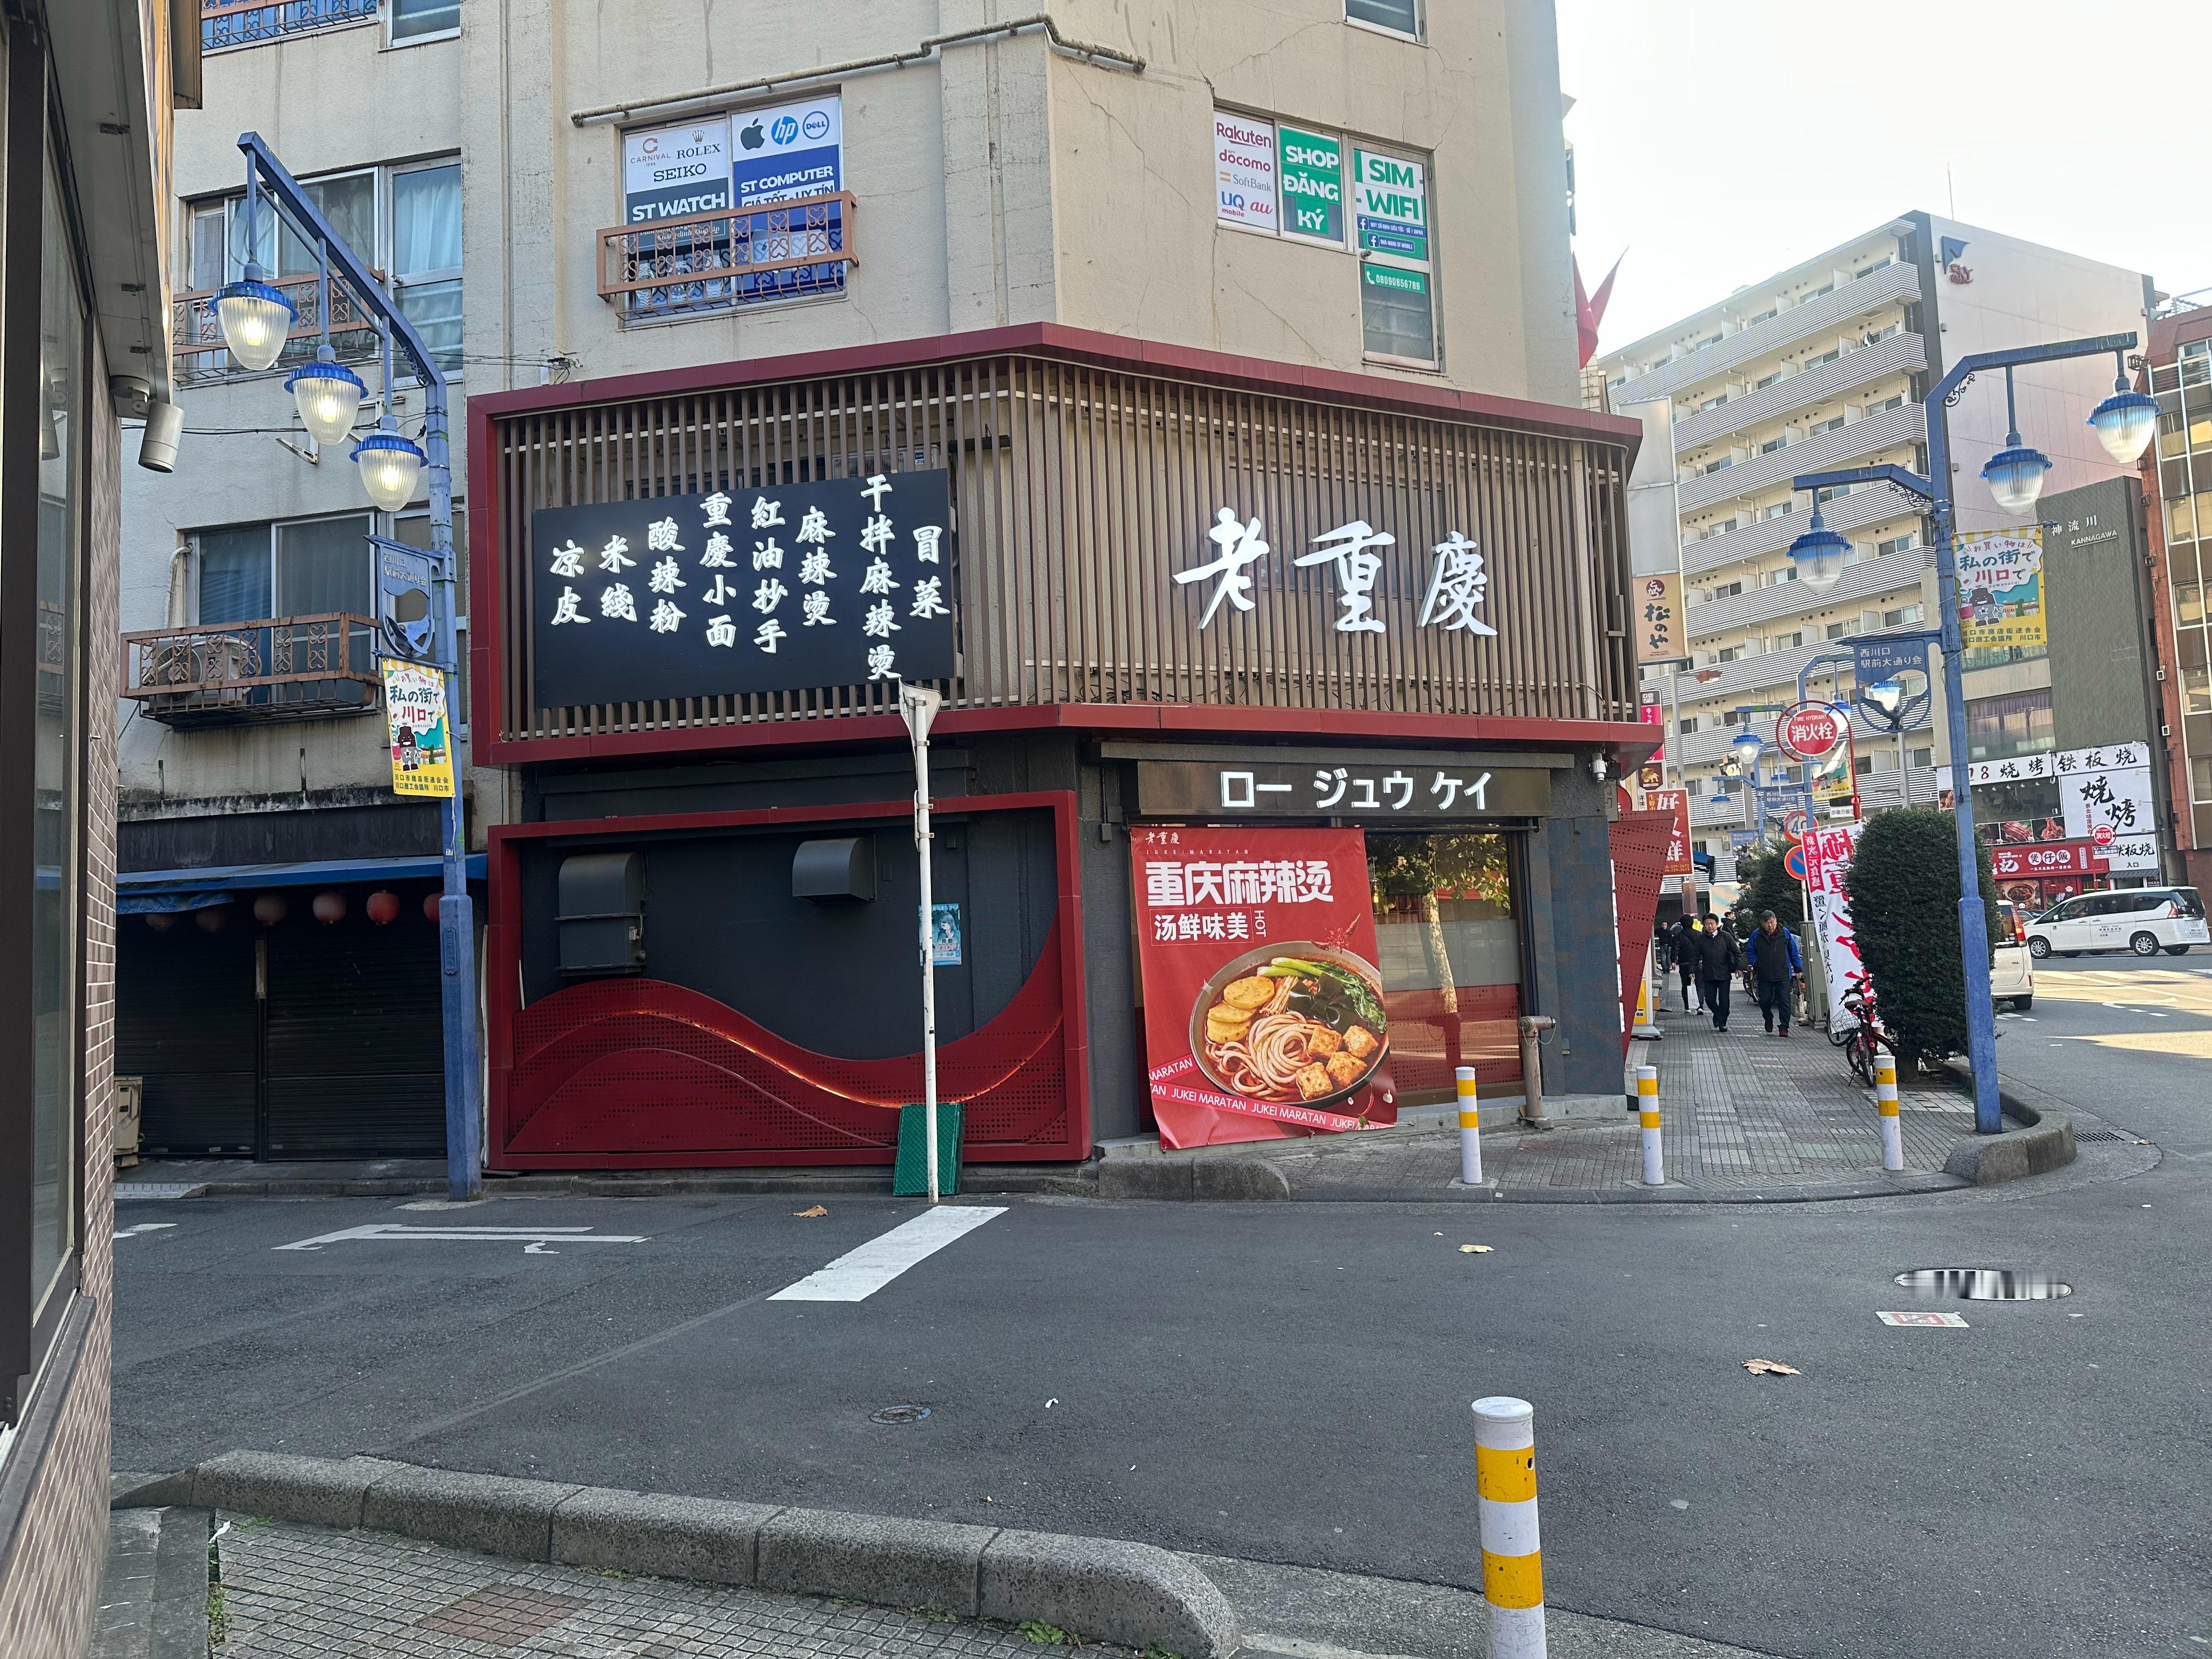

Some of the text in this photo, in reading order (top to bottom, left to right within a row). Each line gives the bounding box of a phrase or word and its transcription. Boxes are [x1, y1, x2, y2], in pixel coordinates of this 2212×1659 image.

[774, 117, 796, 145] hp
[806, 121, 826, 130] DELL
[1216, 122, 1272, 148] Rakuten
[630, 153, 671, 164] CARNIVAL
[676, 144, 720, 159] ROLEX
[1219, 149, 1271, 172] docomo
[1285, 145, 1339, 168] SHOP
[653, 163, 707, 182] SEIKO
[741, 166, 834, 193] ST COMPUTER
[1233, 174, 1272, 192] SoftBank
[1369, 159, 1414, 189] SIM
[1283, 171, 1339, 201] ĐĂNG
[632, 192, 726, 221] ST WATCH
[1221, 191, 1245, 211] UQ
[1222, 208, 1245, 217] mobile
[1250, 201, 1273, 215] au
[1365, 189, 1419, 220] WIFI
[1297, 208, 1325, 230] KÝ
[1376, 274, 1420, 290] 08090856789
[2052, 515, 2097, 537] 神流川
[2071, 530, 2118, 545] KANNAGAWA
[1974, 540, 2025, 552] お買い物は
[699, 491, 737, 648] 重慶小面
[795, 505, 837, 627] 麻辣燙
[1171, 507, 1498, 636] 老重慶
[1959, 549, 2035, 572] 私の街で
[647, 516, 687, 634] 酸辣粉
[751, 495, 788, 654] 紅油抄手
[909, 525, 950, 620] 冒菜
[1975, 568, 2026, 584] 川口で
[1860, 647, 1891, 657] 西川口
[1860, 655, 1922, 669] 駅前大通り会
[390, 684, 440, 705] 私の街で
[402, 706, 435, 724] 川口で
[1791, 721, 1834, 743] 消火栓
[2057, 748, 2137, 772] 铁板烧
[1221, 768, 1492, 810] ロー ジュウ ケイ
[1146, 860, 1334, 906] 重庆麻辣烫
[1154, 912, 1249, 943] 汤鲜味美
[1254, 910, 1267, 938] HOT
[1149, 1057, 1193, 1081] MARATAN
[1171, 1088, 1197, 1102] JUKEI
[1198, 1093, 1247, 1111] MARATAN
[1251, 1102, 1278, 1116] JUKEI
[1279, 1107, 1327, 1125] MARATAN
[1330, 1117, 1355, 1129] JUKEI
